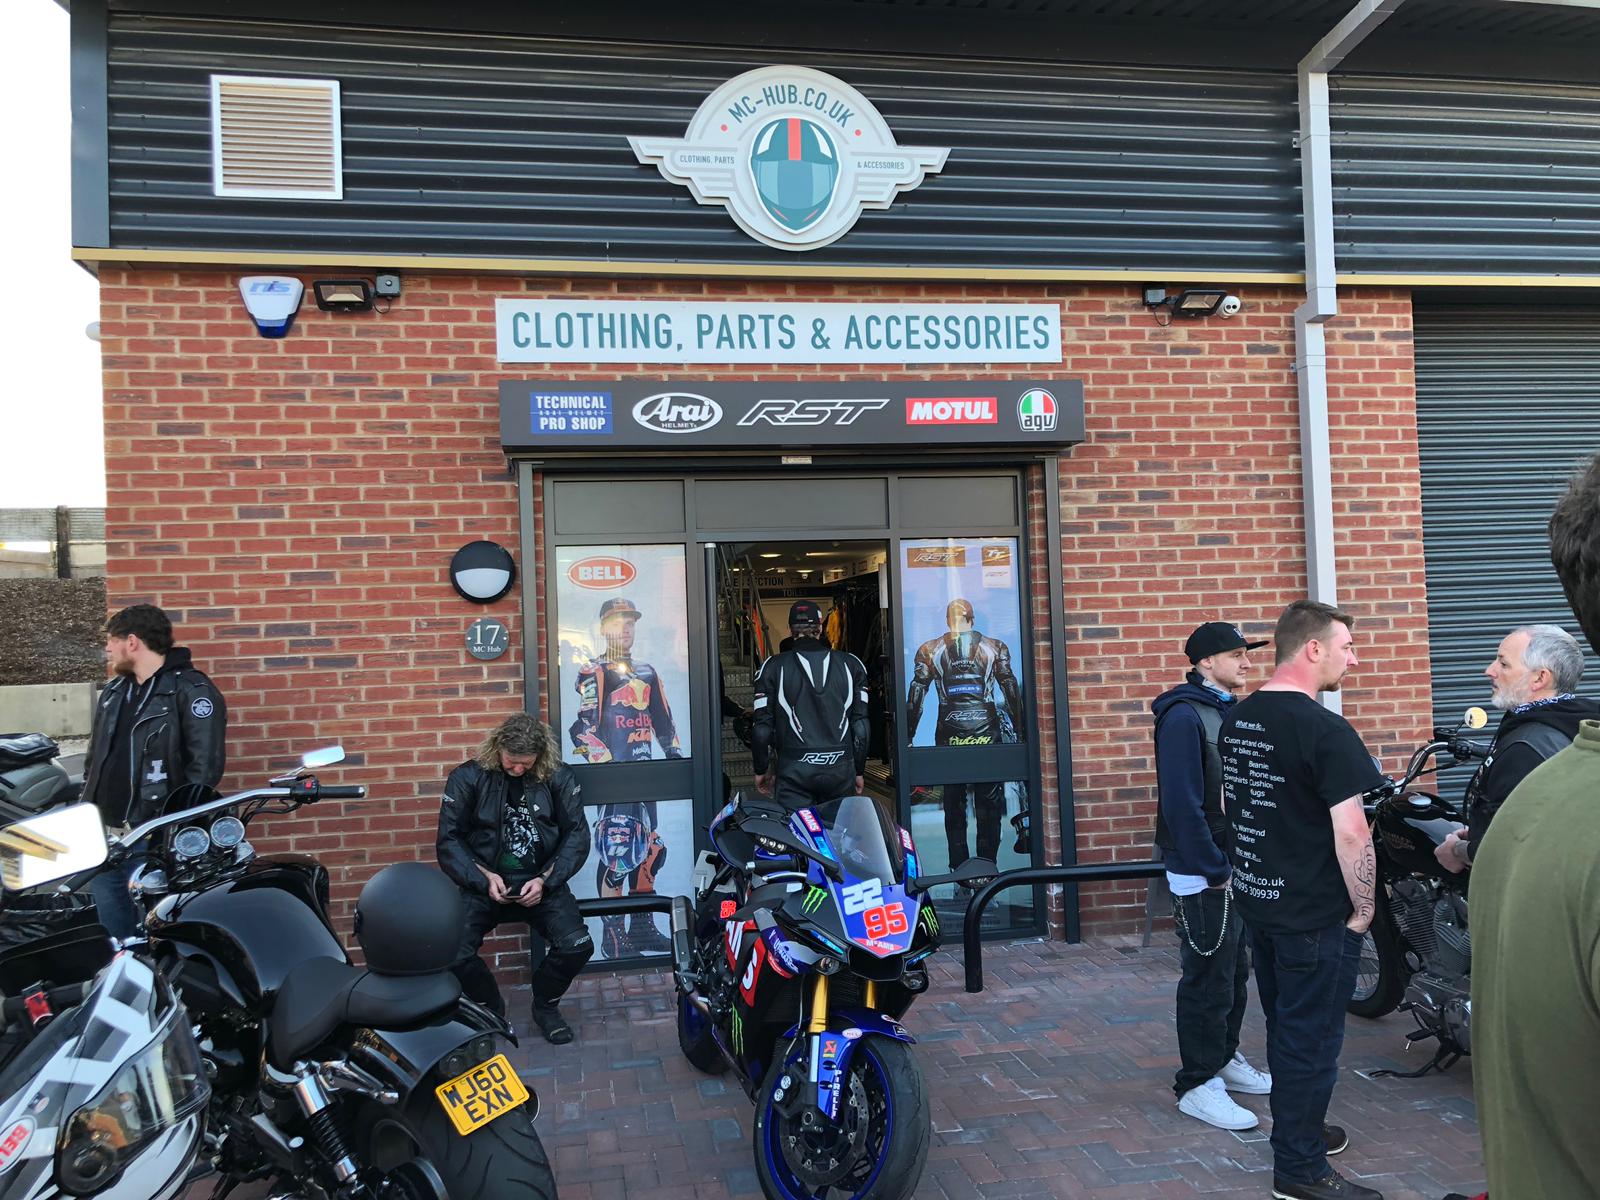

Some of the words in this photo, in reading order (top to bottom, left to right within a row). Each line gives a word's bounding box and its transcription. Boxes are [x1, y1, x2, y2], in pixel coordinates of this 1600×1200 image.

[728, 84, 855, 128] MC-HUB.CO.UK
[715, 155, 735, 165] PARTS
[857, 160, 862, 168] &
[863, 160, 905, 170] ACCESSORIES
[512, 312, 682, 352] CLOTHING,
[697, 313, 796, 349] PARTS
[811, 318, 831, 349] &
[844, 315, 1050, 350] ACCESSORIES
[536, 396, 606, 409] TECHNICAL
[638, 397, 713, 422] Arai
[737, 399, 891, 425] RST
[911, 401, 992, 420] MOTUL
[540, 417, 566, 430] PRO
[572, 417, 605, 430] SHOP
[1024, 415, 1053, 431] agv
[578, 566, 626, 580] BELL
[474, 624, 500, 645] 17
[798, 751, 845, 764] RST
[1249, 769, 1269, 779] Phone
[842, 877, 885, 916] 22
[863, 902, 908, 940] 95
[443, 1062, 507, 1108] WJ60
[464, 1084, 514, 1123] EXN
